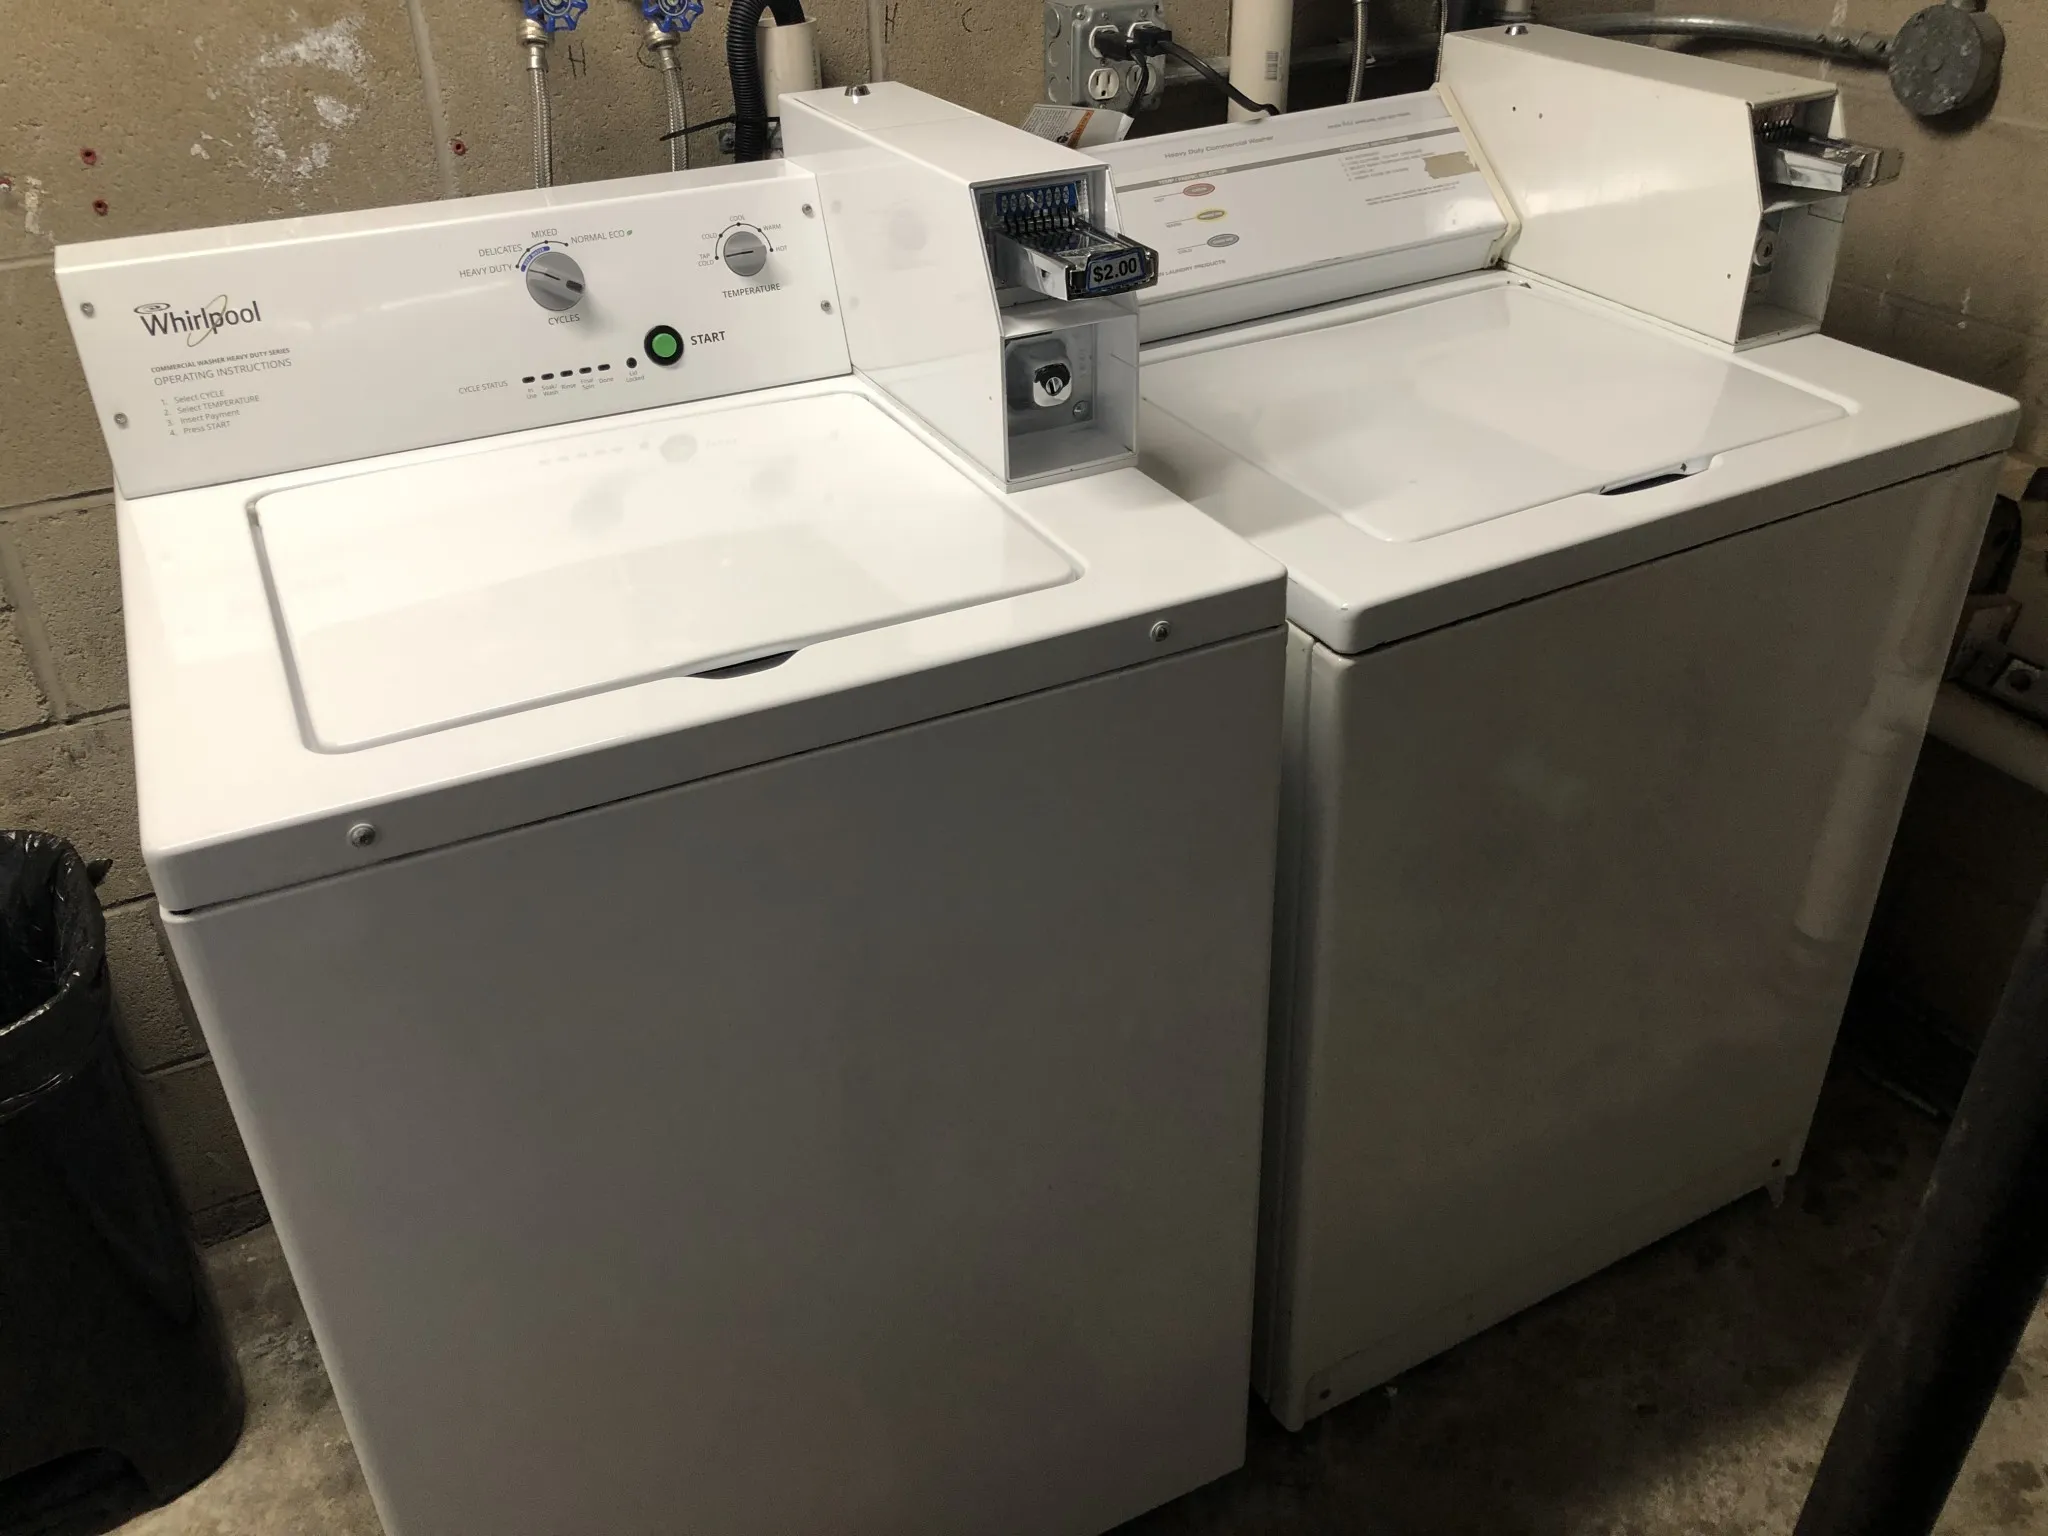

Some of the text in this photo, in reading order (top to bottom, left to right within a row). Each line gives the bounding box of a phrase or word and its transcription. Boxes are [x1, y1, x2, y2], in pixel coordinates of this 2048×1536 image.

[885, 3, 898, 44] H
[568, 41, 587, 77] H
[1164, 135, 1274, 159] Heavy Duty Commercial Washer
[729, 214, 745, 222] COOL
[531, 228, 558, 239] MIXED
[763, 223, 781, 231] WARM
[571, 230, 625, 244] NORMAL ECO
[701, 232, 718, 240] COLD
[479, 244, 523, 257] DELICATES
[699, 252, 711, 260] TAP
[698, 259, 714, 267] COLD
[1093, 257, 1137, 283] $2.00
[459, 263, 513, 278] HEAVY DUTY
[1165, 265, 1193, 276] LAUNDRY
[722, 283, 781, 298] TEMPERATURE
[139, 300, 262, 337] Whirlpool
[548, 313, 581, 326] CYCLES
[691, 330, 726, 346] START
[151, 347, 290, 373] COMMERCIAL WASHER HEAVY DUTY SERIES
[154, 358, 292, 386] OPERATING INSTRUCTIONS
[599, 376, 614, 384] Done
[458, 380, 509, 395] CYCLE STATUS
[174, 394, 198, 404] Select
[200, 390, 225, 400] CYCLE
[177, 404, 201, 414] Select
[203, 395, 260, 410] TEMPERATURE
[205, 409, 240, 421] Payment
[184, 426, 206, 434] Press
[206, 421, 230, 431] START
